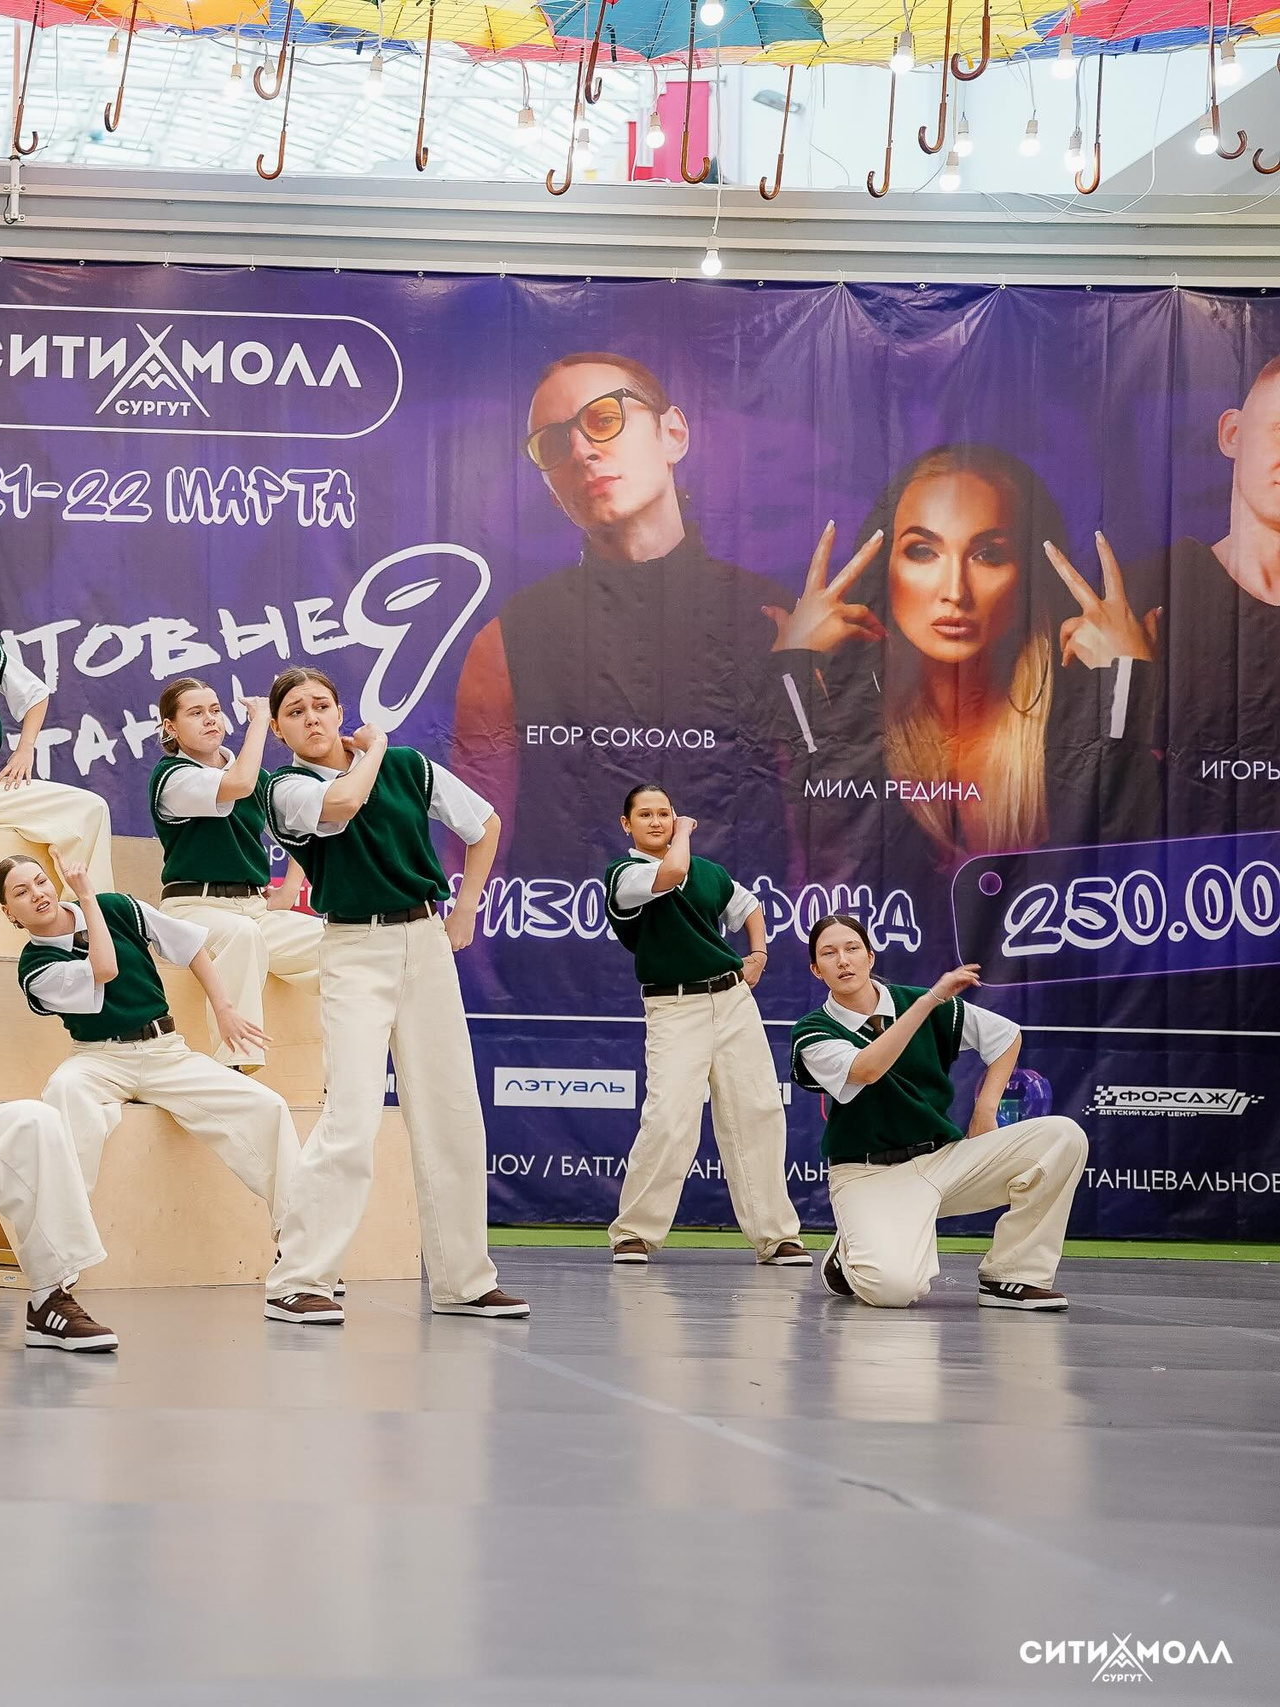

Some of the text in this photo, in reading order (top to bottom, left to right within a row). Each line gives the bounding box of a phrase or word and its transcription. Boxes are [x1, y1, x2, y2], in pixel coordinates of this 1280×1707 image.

[114, 400, 191, 417] СУРГУТ
[166, 466, 356, 528] МАРТА
[526, 725, 716, 749] ЕГОР СОКОЛОВ
[1202, 760, 1280, 780] ИГОРЬ
[804, 779, 982, 804] МИЛА РЕДИНА
[1119, 1090, 1229, 1104] ФОРСАЖ
